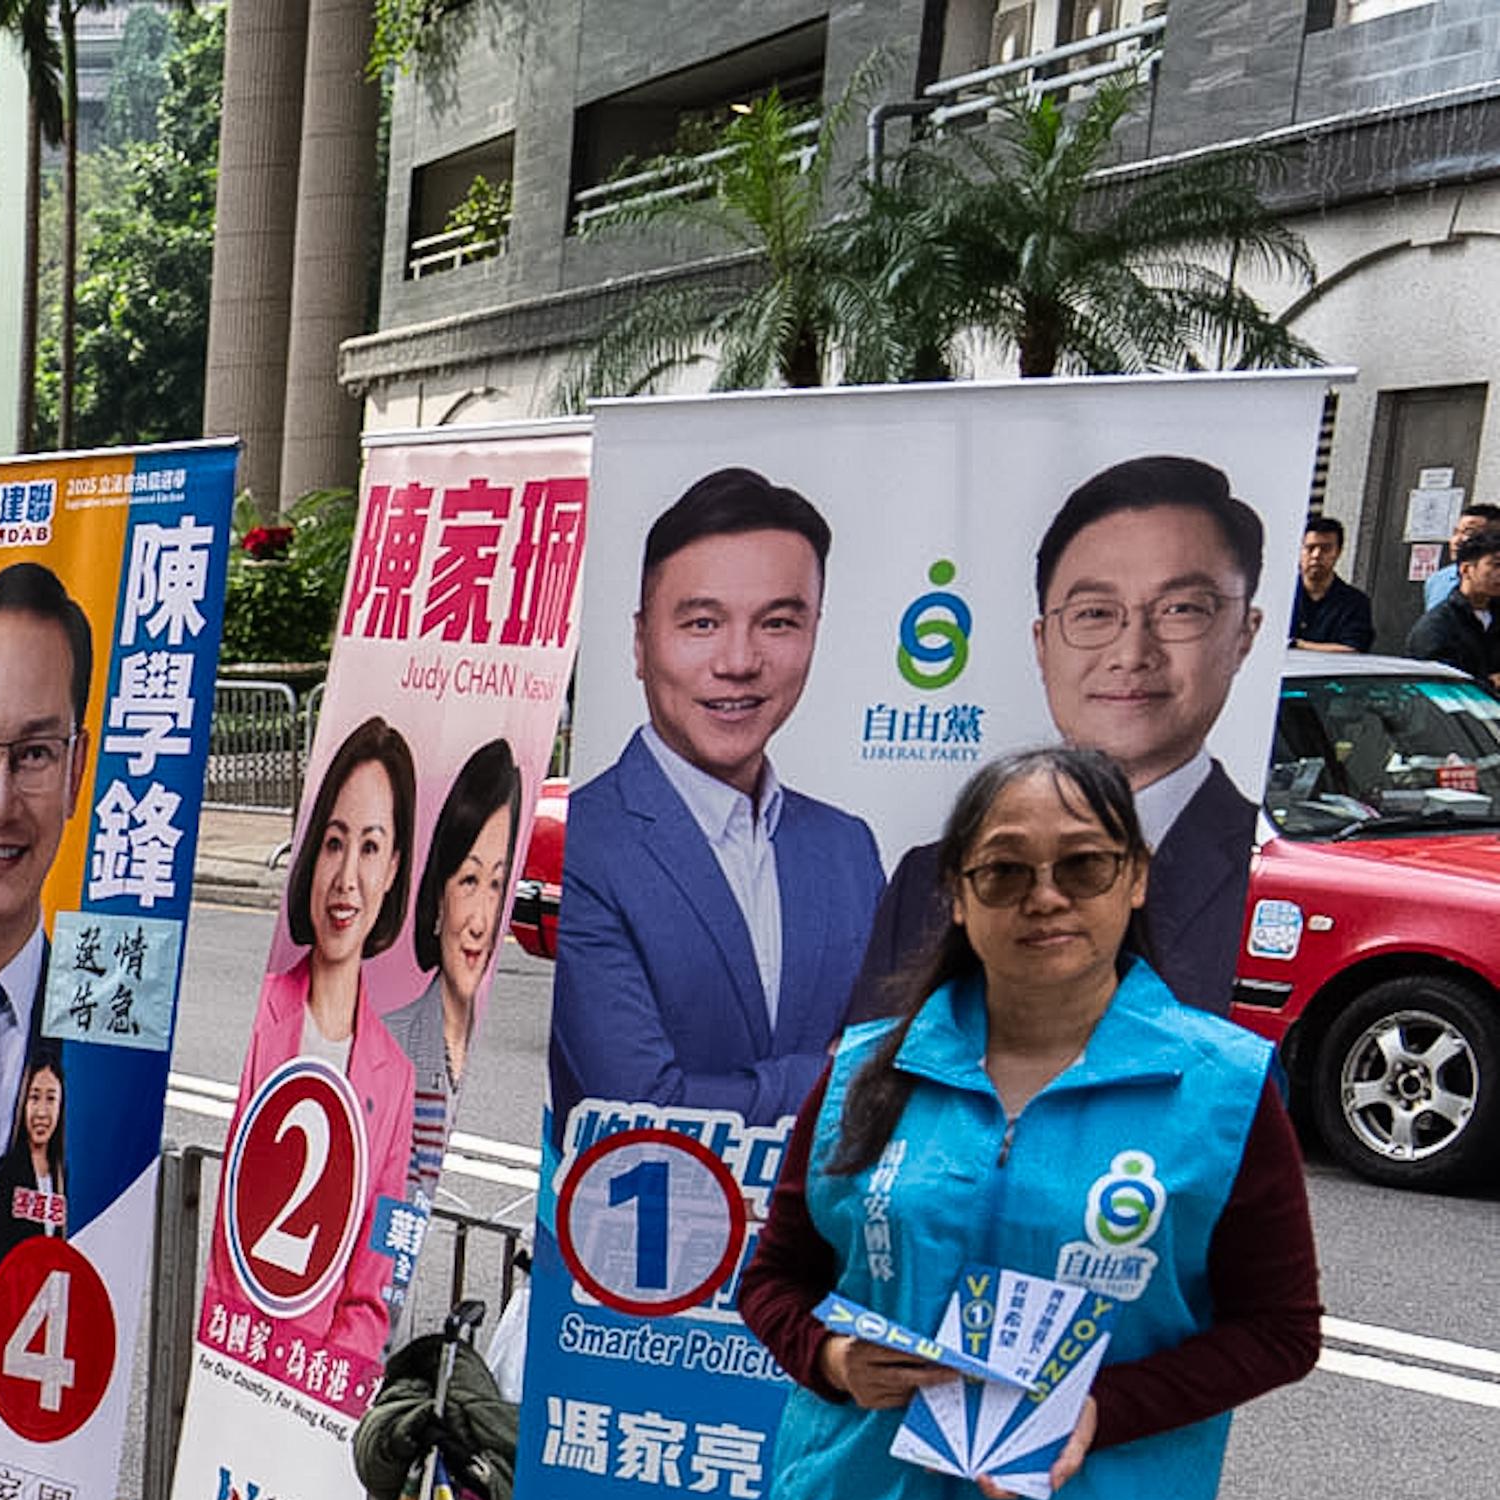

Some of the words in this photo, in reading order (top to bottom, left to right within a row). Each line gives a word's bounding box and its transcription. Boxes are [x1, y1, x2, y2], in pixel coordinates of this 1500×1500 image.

[66, 478, 97, 496] 2025
[7, 526, 48, 544] DAB
[341, 476, 590, 649] 陳家珮
[401, 655, 449, 702] Judy
[454, 658, 519, 698] CHAN
[88, 515, 214, 909] 陳學鋒
[863, 703, 986, 743] 自由黨
[861, 746, 924, 761] LIBERAL
[929, 747, 979, 762] PARTY
[250, 1097, 331, 1277] 2
[608, 1160, 670, 1291] 1
[1062, 1250, 1149, 1282] 自由黨
[2, 1270, 76, 1413] 4
[562, 1315, 683, 1365] Smarter
[275, 1389, 291, 1410] For
[294, 1400, 318, 1428] Hong
[541, 1395, 767, 1500] 馮家亮
